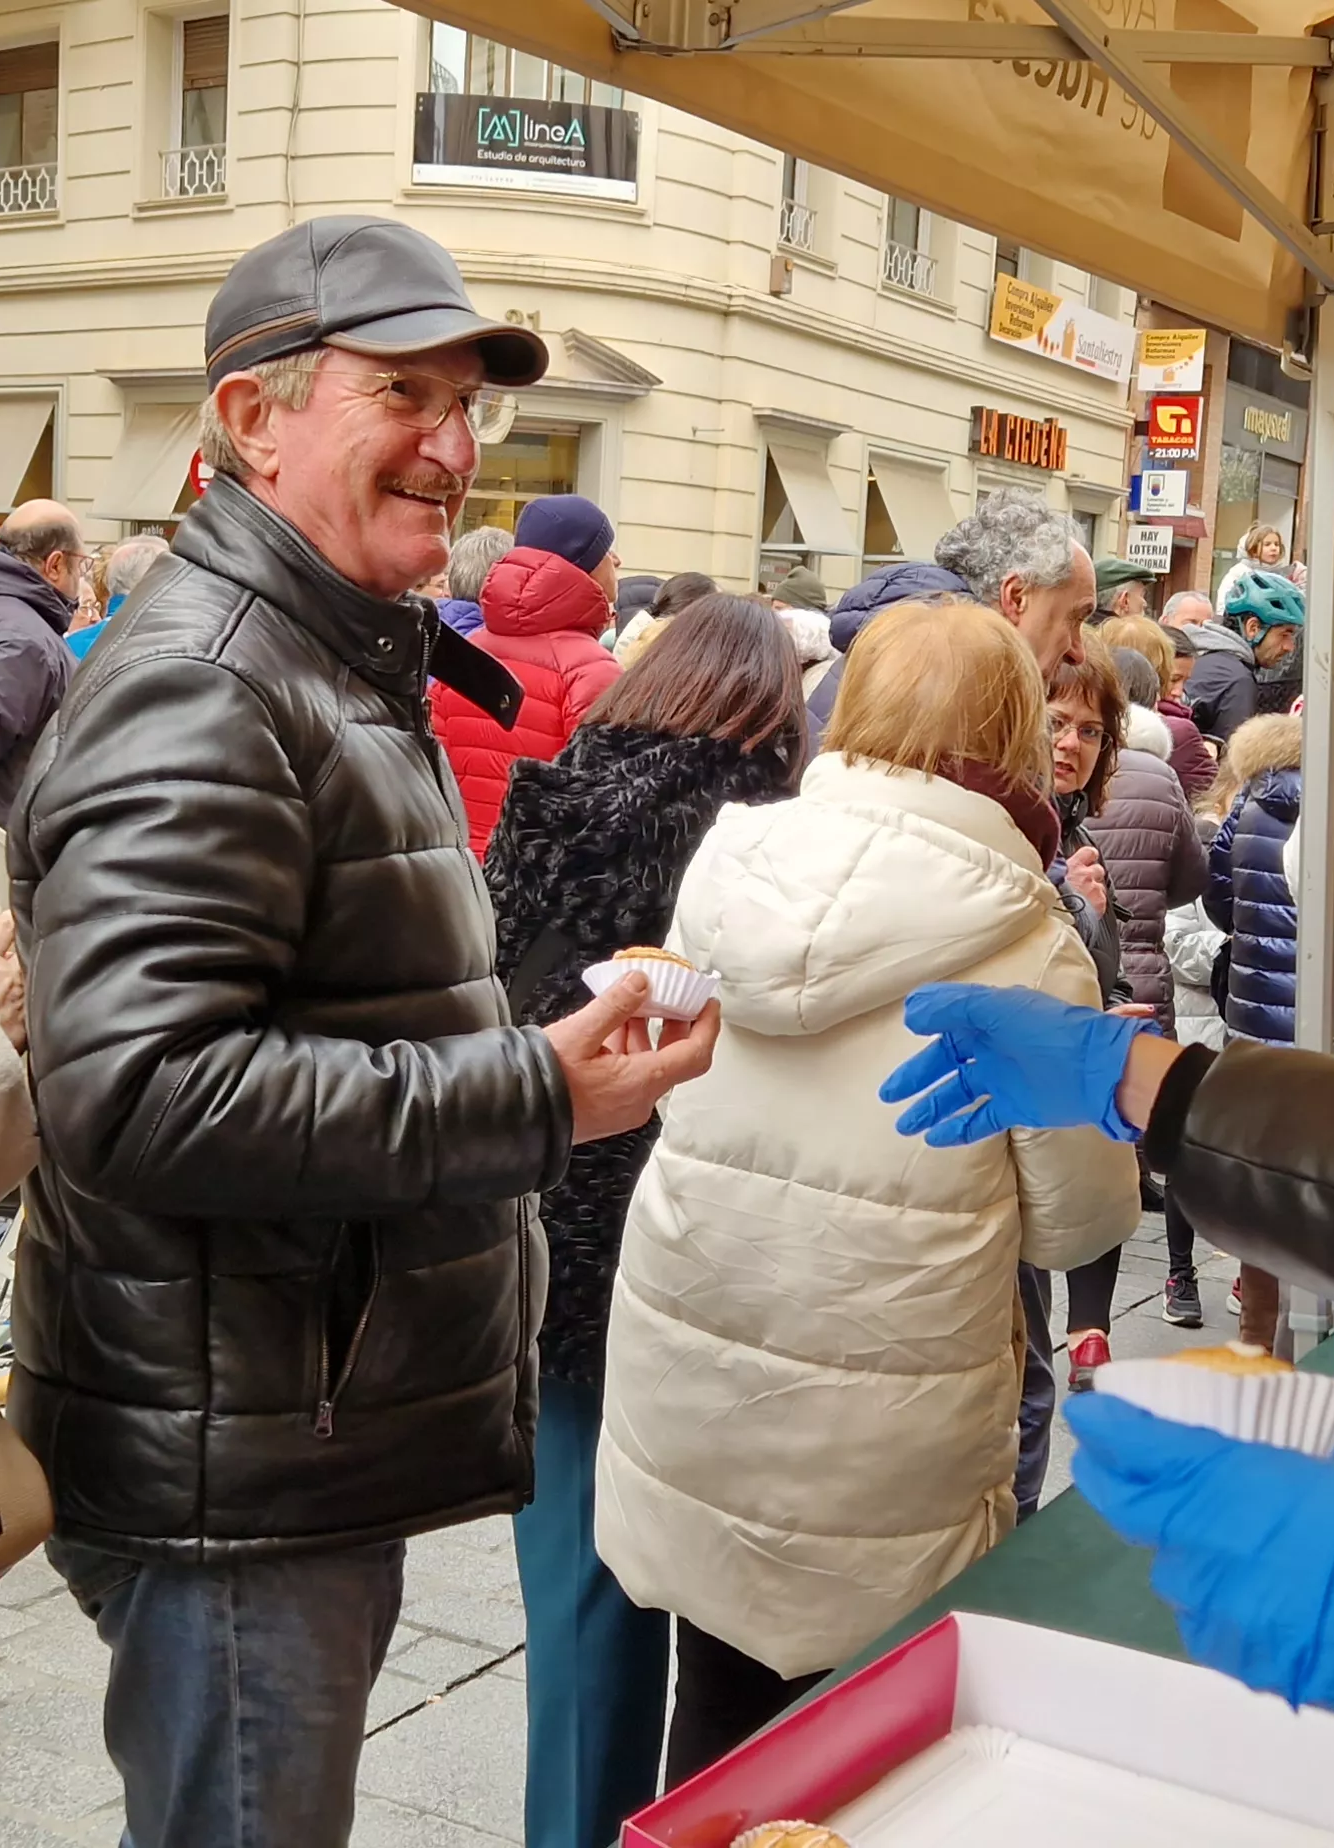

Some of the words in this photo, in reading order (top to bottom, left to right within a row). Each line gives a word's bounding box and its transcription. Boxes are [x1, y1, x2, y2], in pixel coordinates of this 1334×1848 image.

[477, 149, 513, 161] Estudio
[514, 151, 527, 162] de
[528, 155, 586, 168] arquitectura
[979, 407, 998, 456] LA
[1151, 436, 1194, 444] TABACOS
[1155, 448, 1180, 458] 21:00
[1141, 531, 1159, 541] HAY
[1129, 544, 1168, 556] LOTERIA
